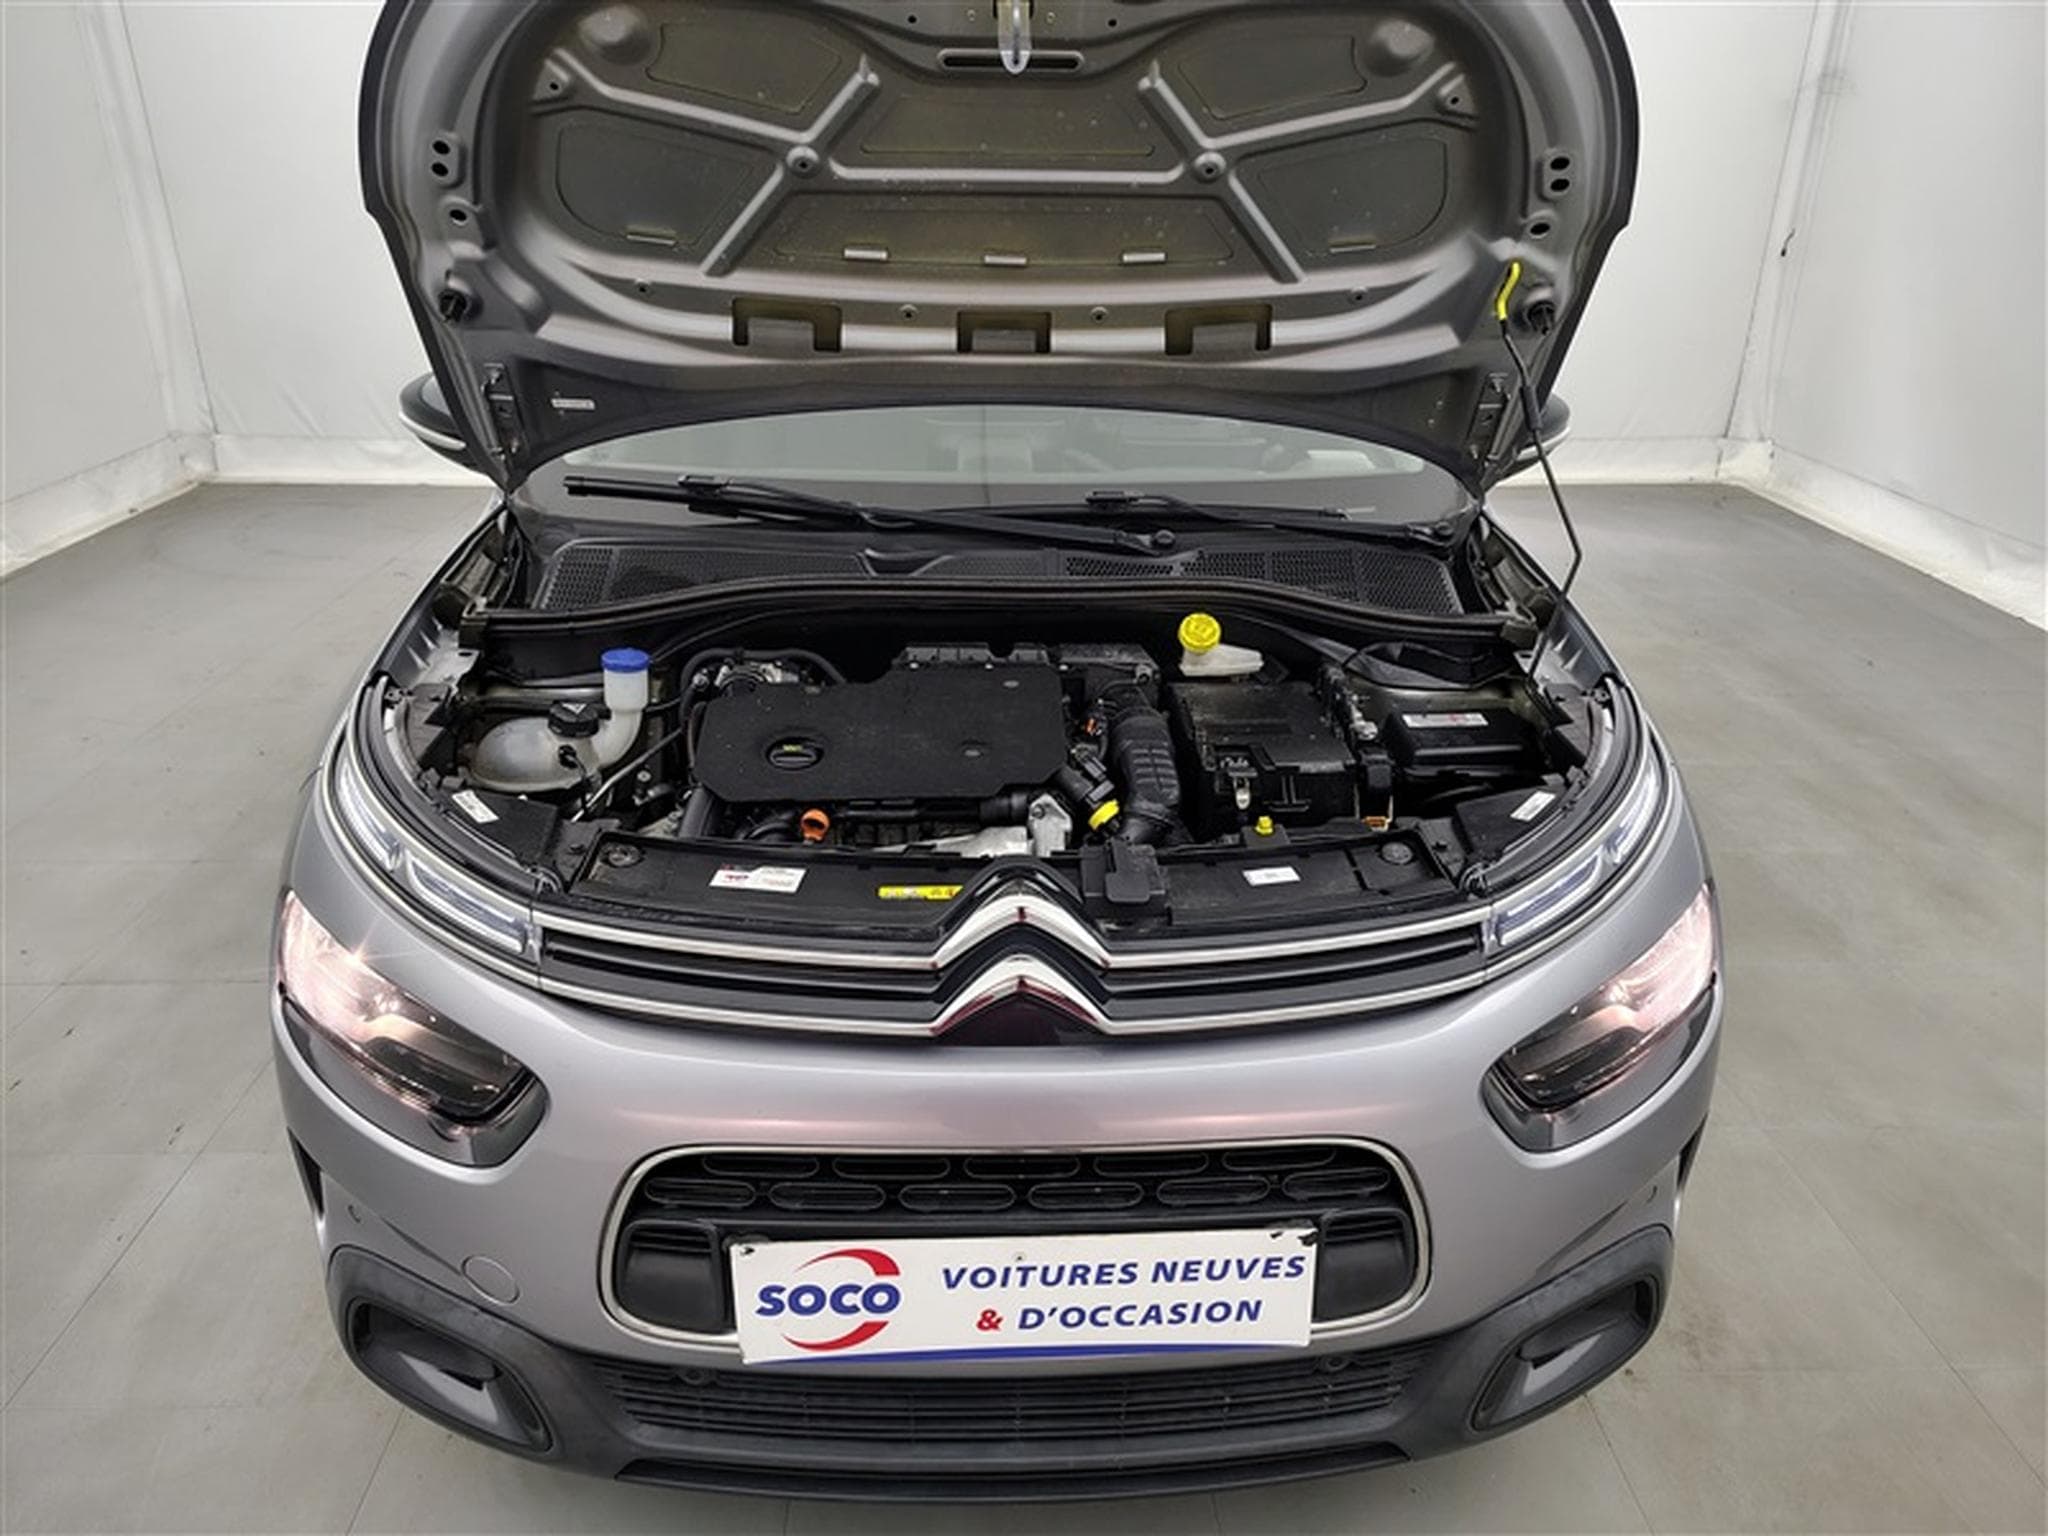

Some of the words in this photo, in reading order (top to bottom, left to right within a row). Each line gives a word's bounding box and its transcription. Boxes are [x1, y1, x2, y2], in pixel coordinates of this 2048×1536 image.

[942, 1262, 1138, 1290] VOITURES
[1151, 1255, 1306, 1283] NEUVES
[755, 1282, 902, 1317] SOCO
[976, 1308, 1004, 1332] &
[1018, 1299, 1263, 1330] D'OCCASION
